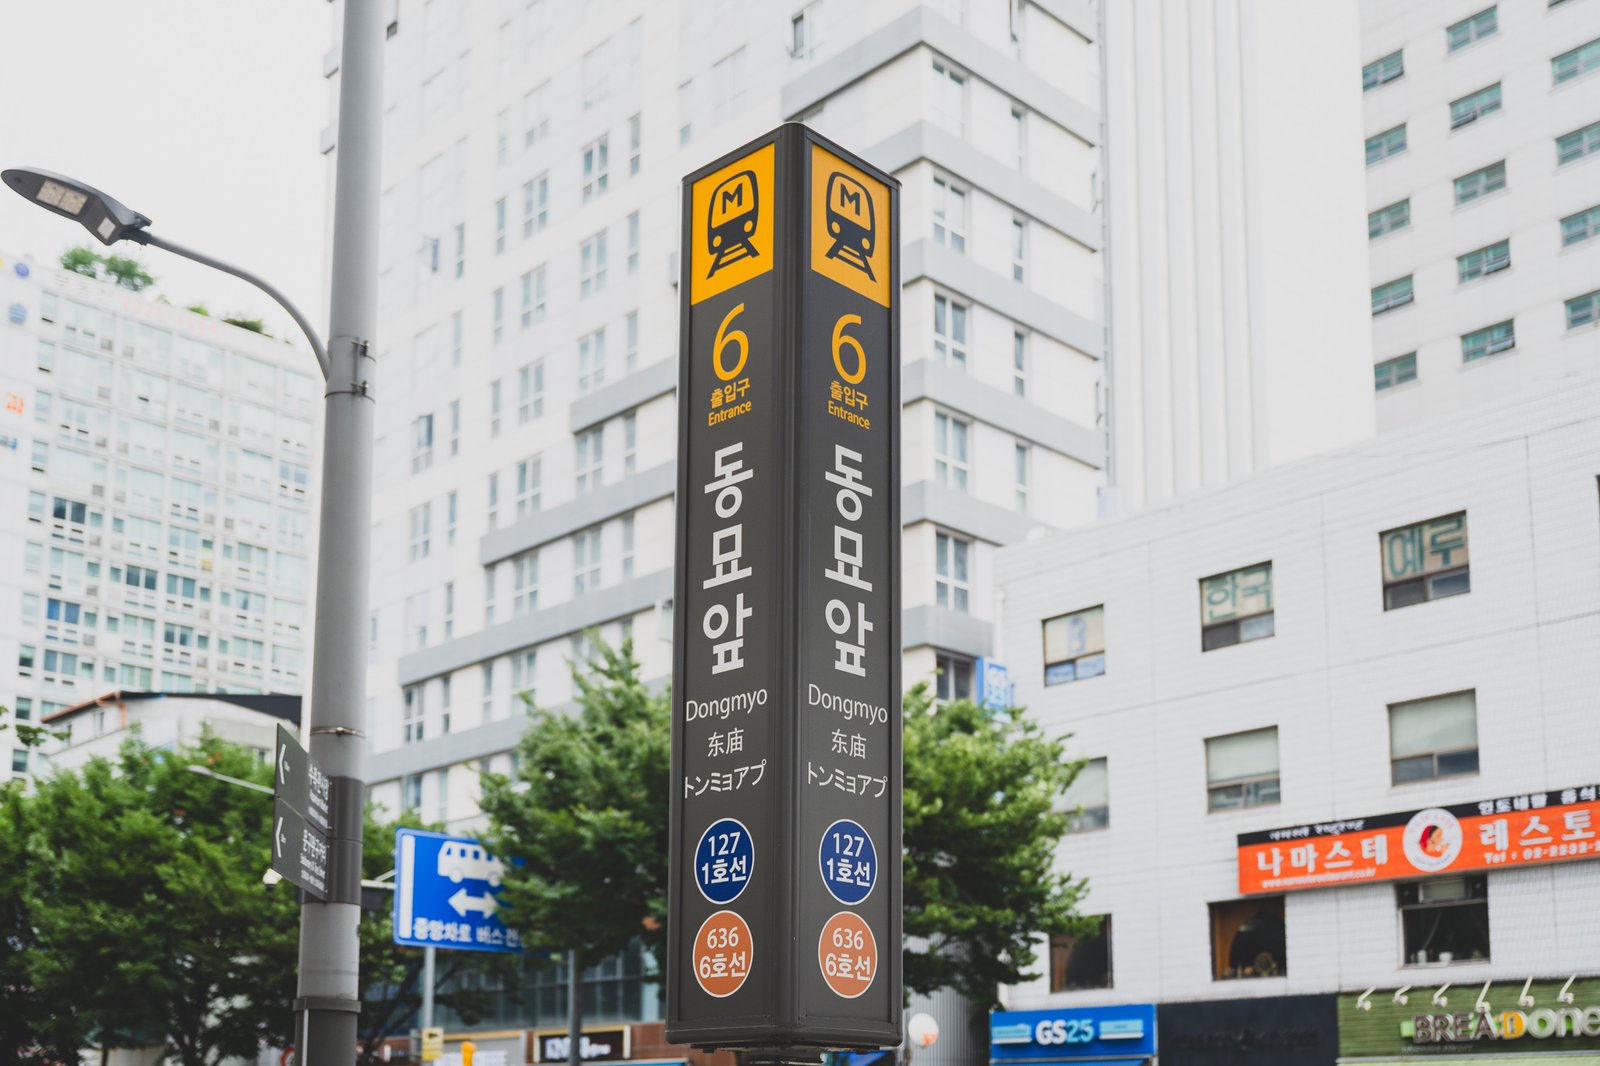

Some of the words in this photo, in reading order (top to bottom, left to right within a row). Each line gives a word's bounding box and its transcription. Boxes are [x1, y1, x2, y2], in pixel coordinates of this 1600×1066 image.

[713, 303, 749, 381] 6
[831, 314, 867, 385] 6
[710, 377, 751, 409] 출입구
[830, 380, 868, 411] 출입구
[708, 401, 752, 427] Entrance
[828, 400, 870, 430] Entrance
[703, 442, 753, 675] 동묘앞
[825, 444, 873, 677] 동묘앞
[686, 689, 768, 722] Dongmyo
[808, 683, 888, 725] Dongmyo
[707, 727, 745, 757] 东庙
[831, 728, 867, 759] 东庙
[1561, 785, 1600, 805] 음식
[708, 832, 741, 857] 127
[833, 832, 865, 857] 127
[1479, 809, 1596, 851] 레스토
[702, 855, 746, 885] 1호선
[1256, 833, 1389, 877] 나마스테
[1483, 850, 1506, 864] Tel
[827, 858, 871, 887] 1호선
[707, 926, 739, 949] 636
[832, 927, 864, 950] 636
[700, 951, 746, 979] 6호선
[825, 953, 871, 981] 6호선
[1035, 1018, 1095, 1046] GS25
